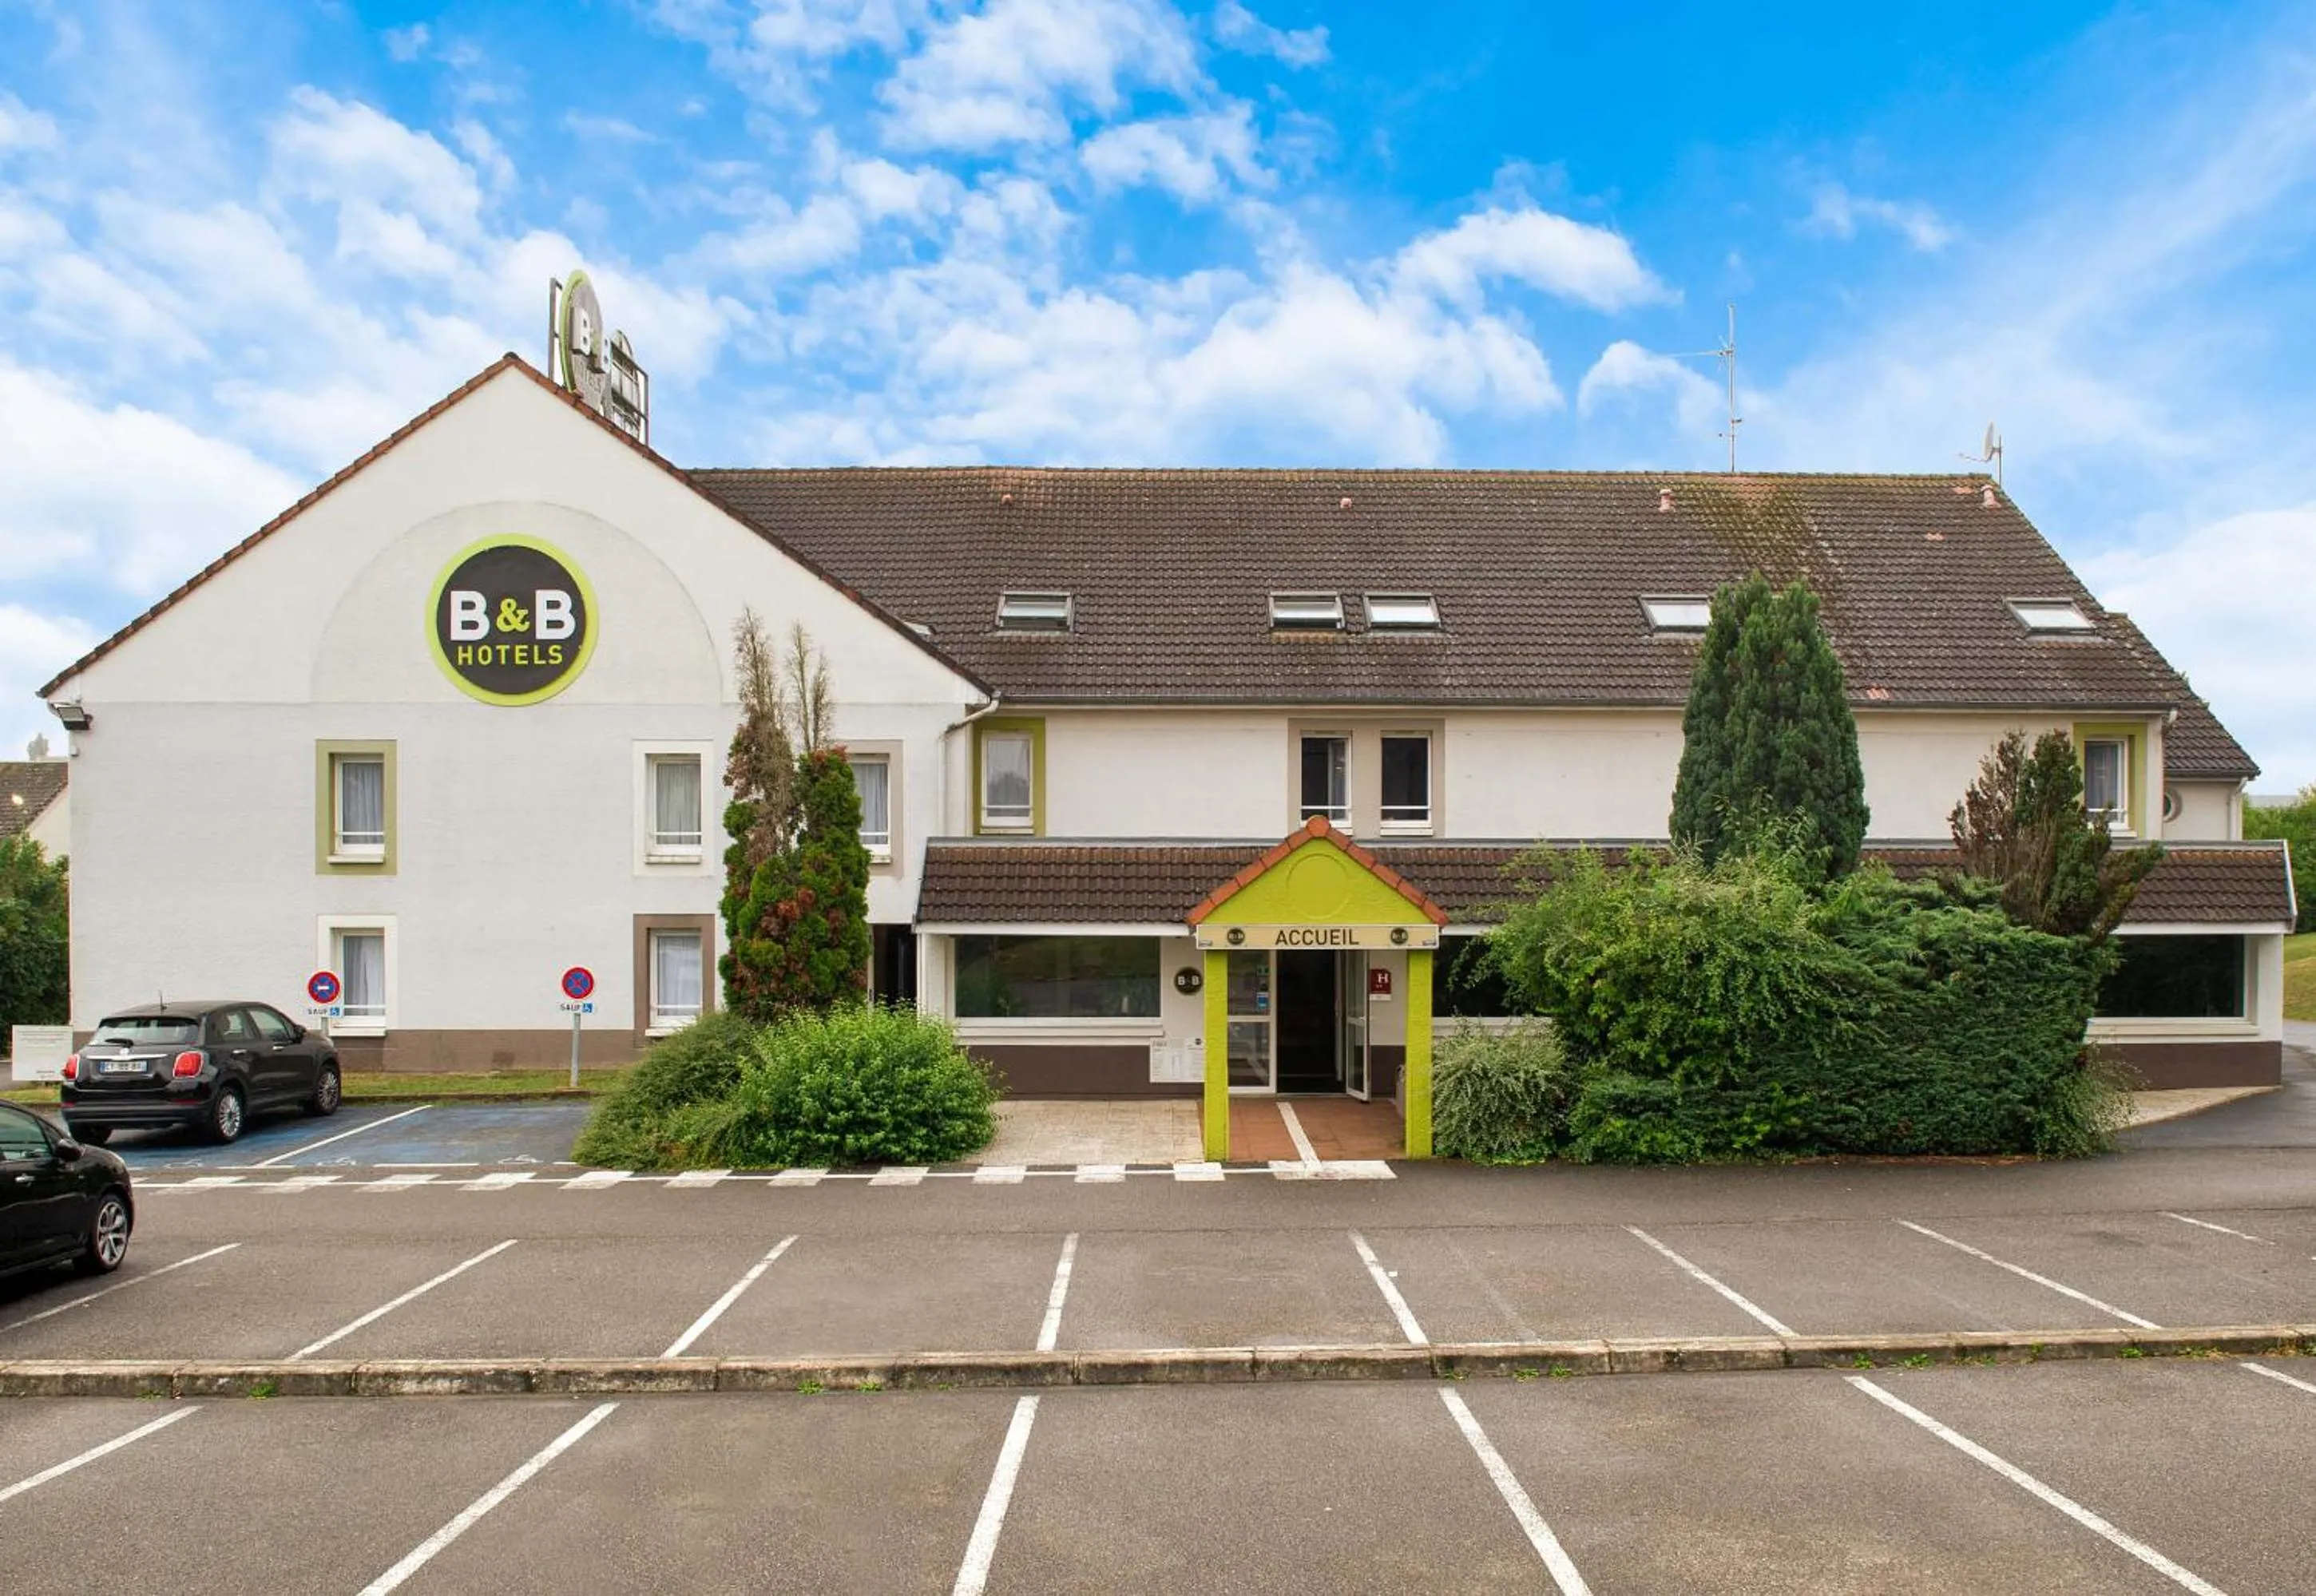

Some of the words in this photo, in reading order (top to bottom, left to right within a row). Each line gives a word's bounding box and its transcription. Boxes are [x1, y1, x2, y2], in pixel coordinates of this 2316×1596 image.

[458, 644, 563, 666] HOTELS
[1275, 929, 1359, 945] ACCUEIL
[1378, 972, 1389, 984] H
